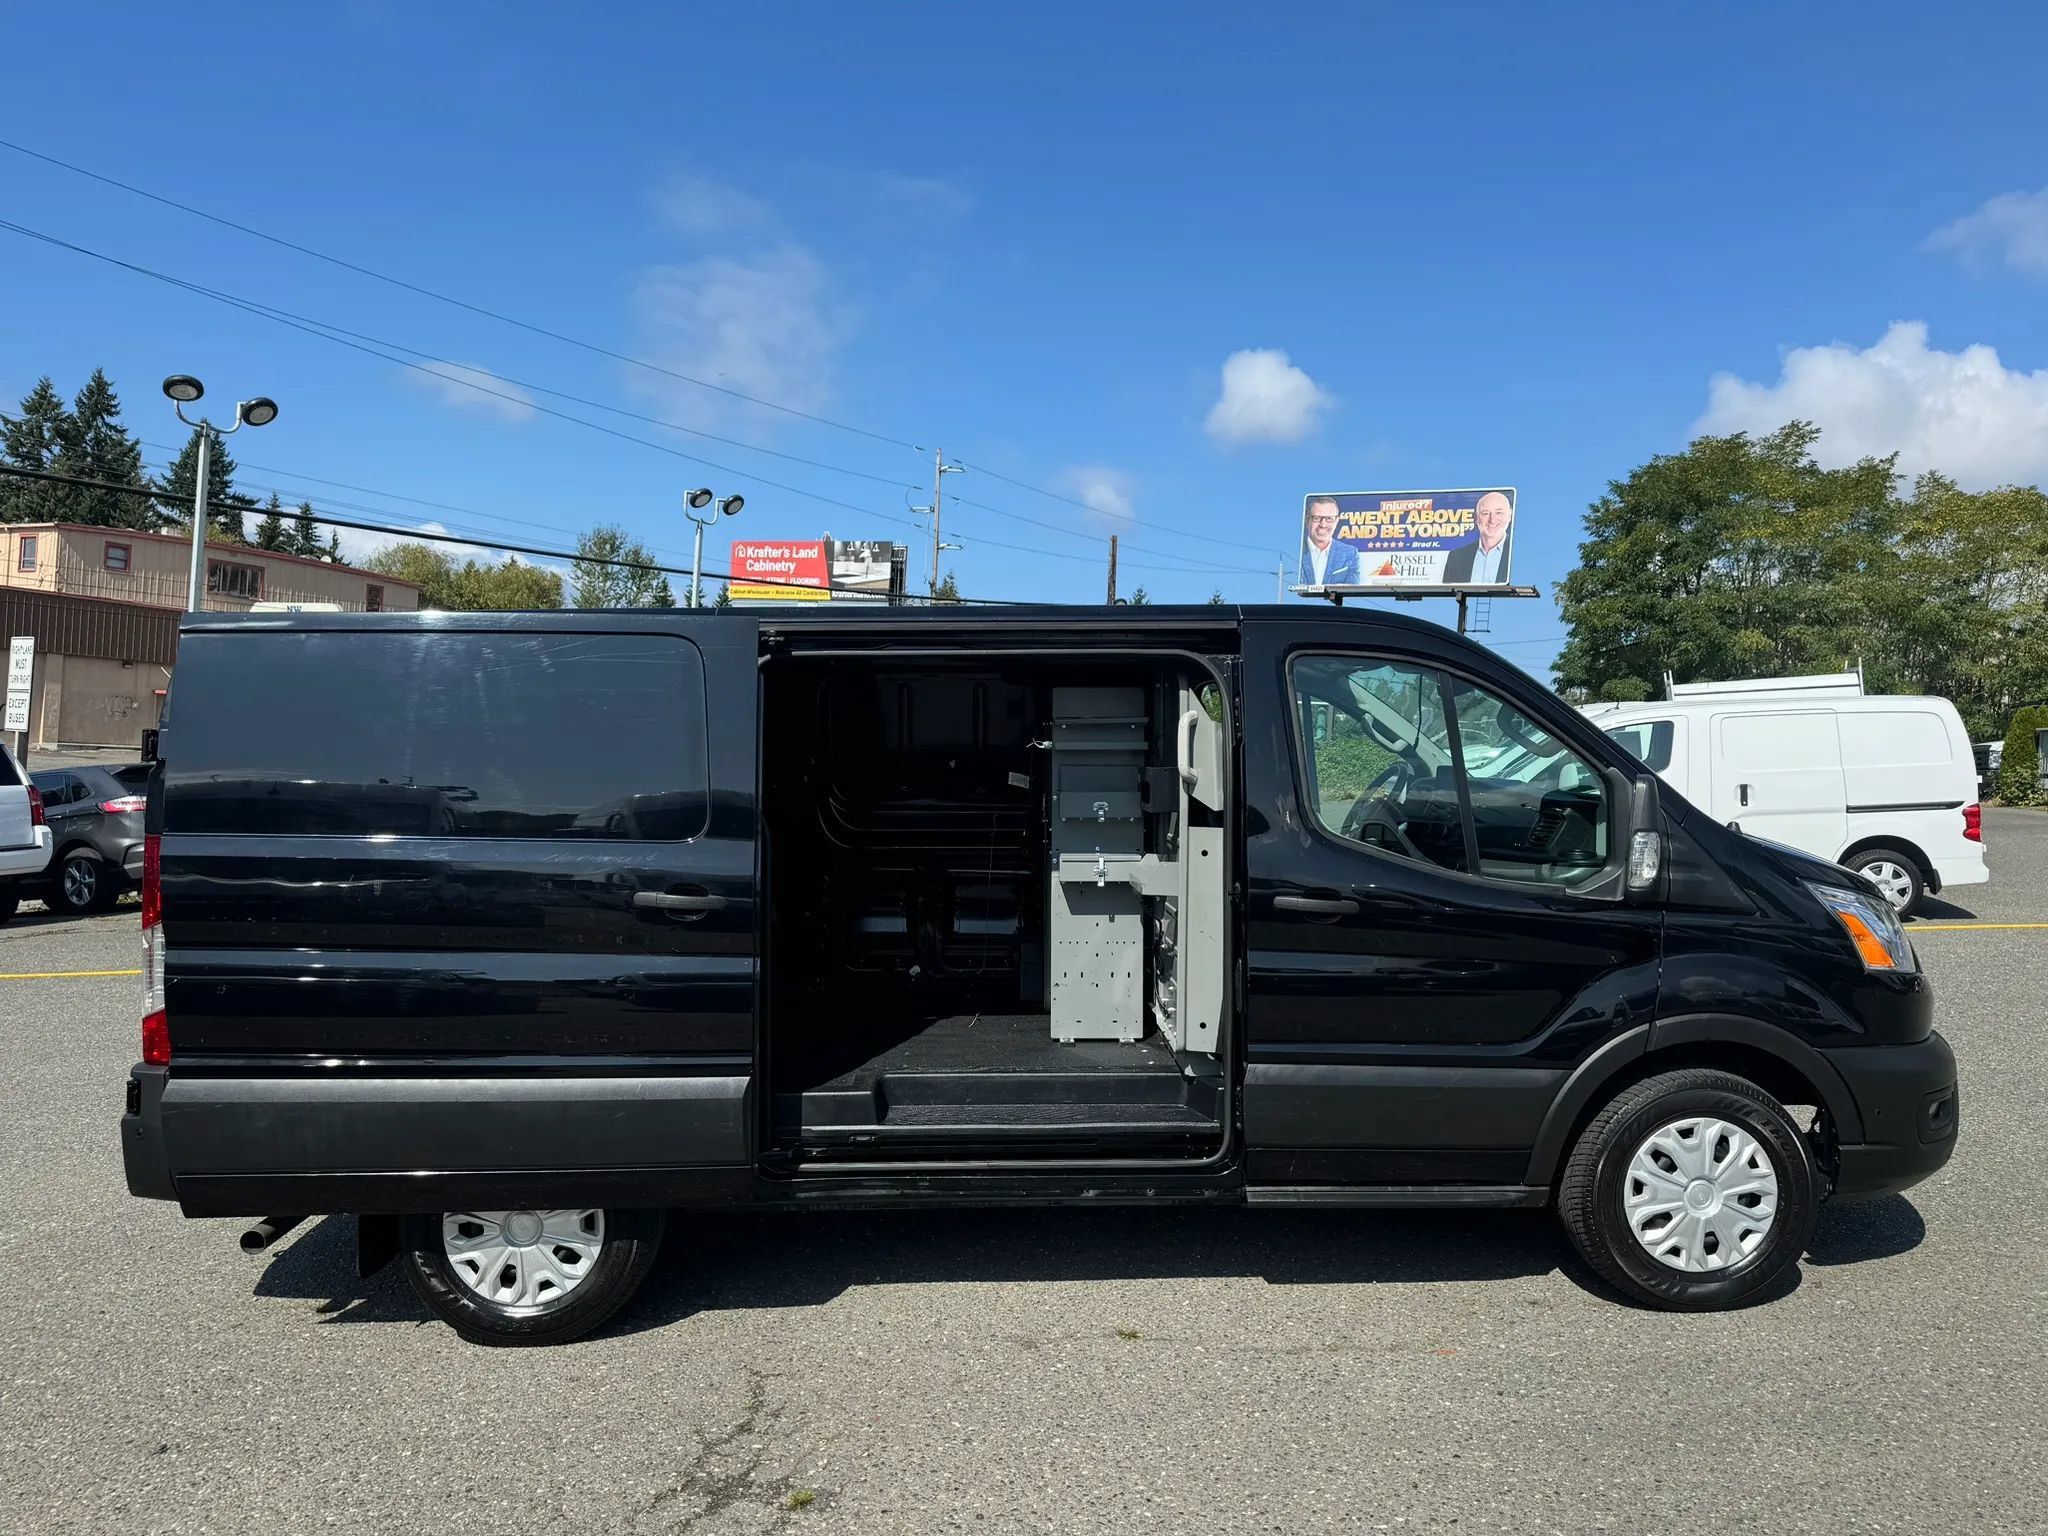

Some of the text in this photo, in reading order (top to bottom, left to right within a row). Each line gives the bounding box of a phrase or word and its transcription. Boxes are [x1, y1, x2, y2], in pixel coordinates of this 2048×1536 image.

[1406, 509, 1475, 524] ABOVE
[1337, 525, 1378, 539] AND
[746, 545, 819, 559] Krafter's Land
[1389, 554, 1435, 566] RUSSELL
[746, 559, 796, 574] Cabinetry
[1400, 565, 1428, 576] HILL
[15, 658, 27, 670] MUST
[8, 698, 28, 709] EXCEPT
[8, 712, 25, 723] BUSES
